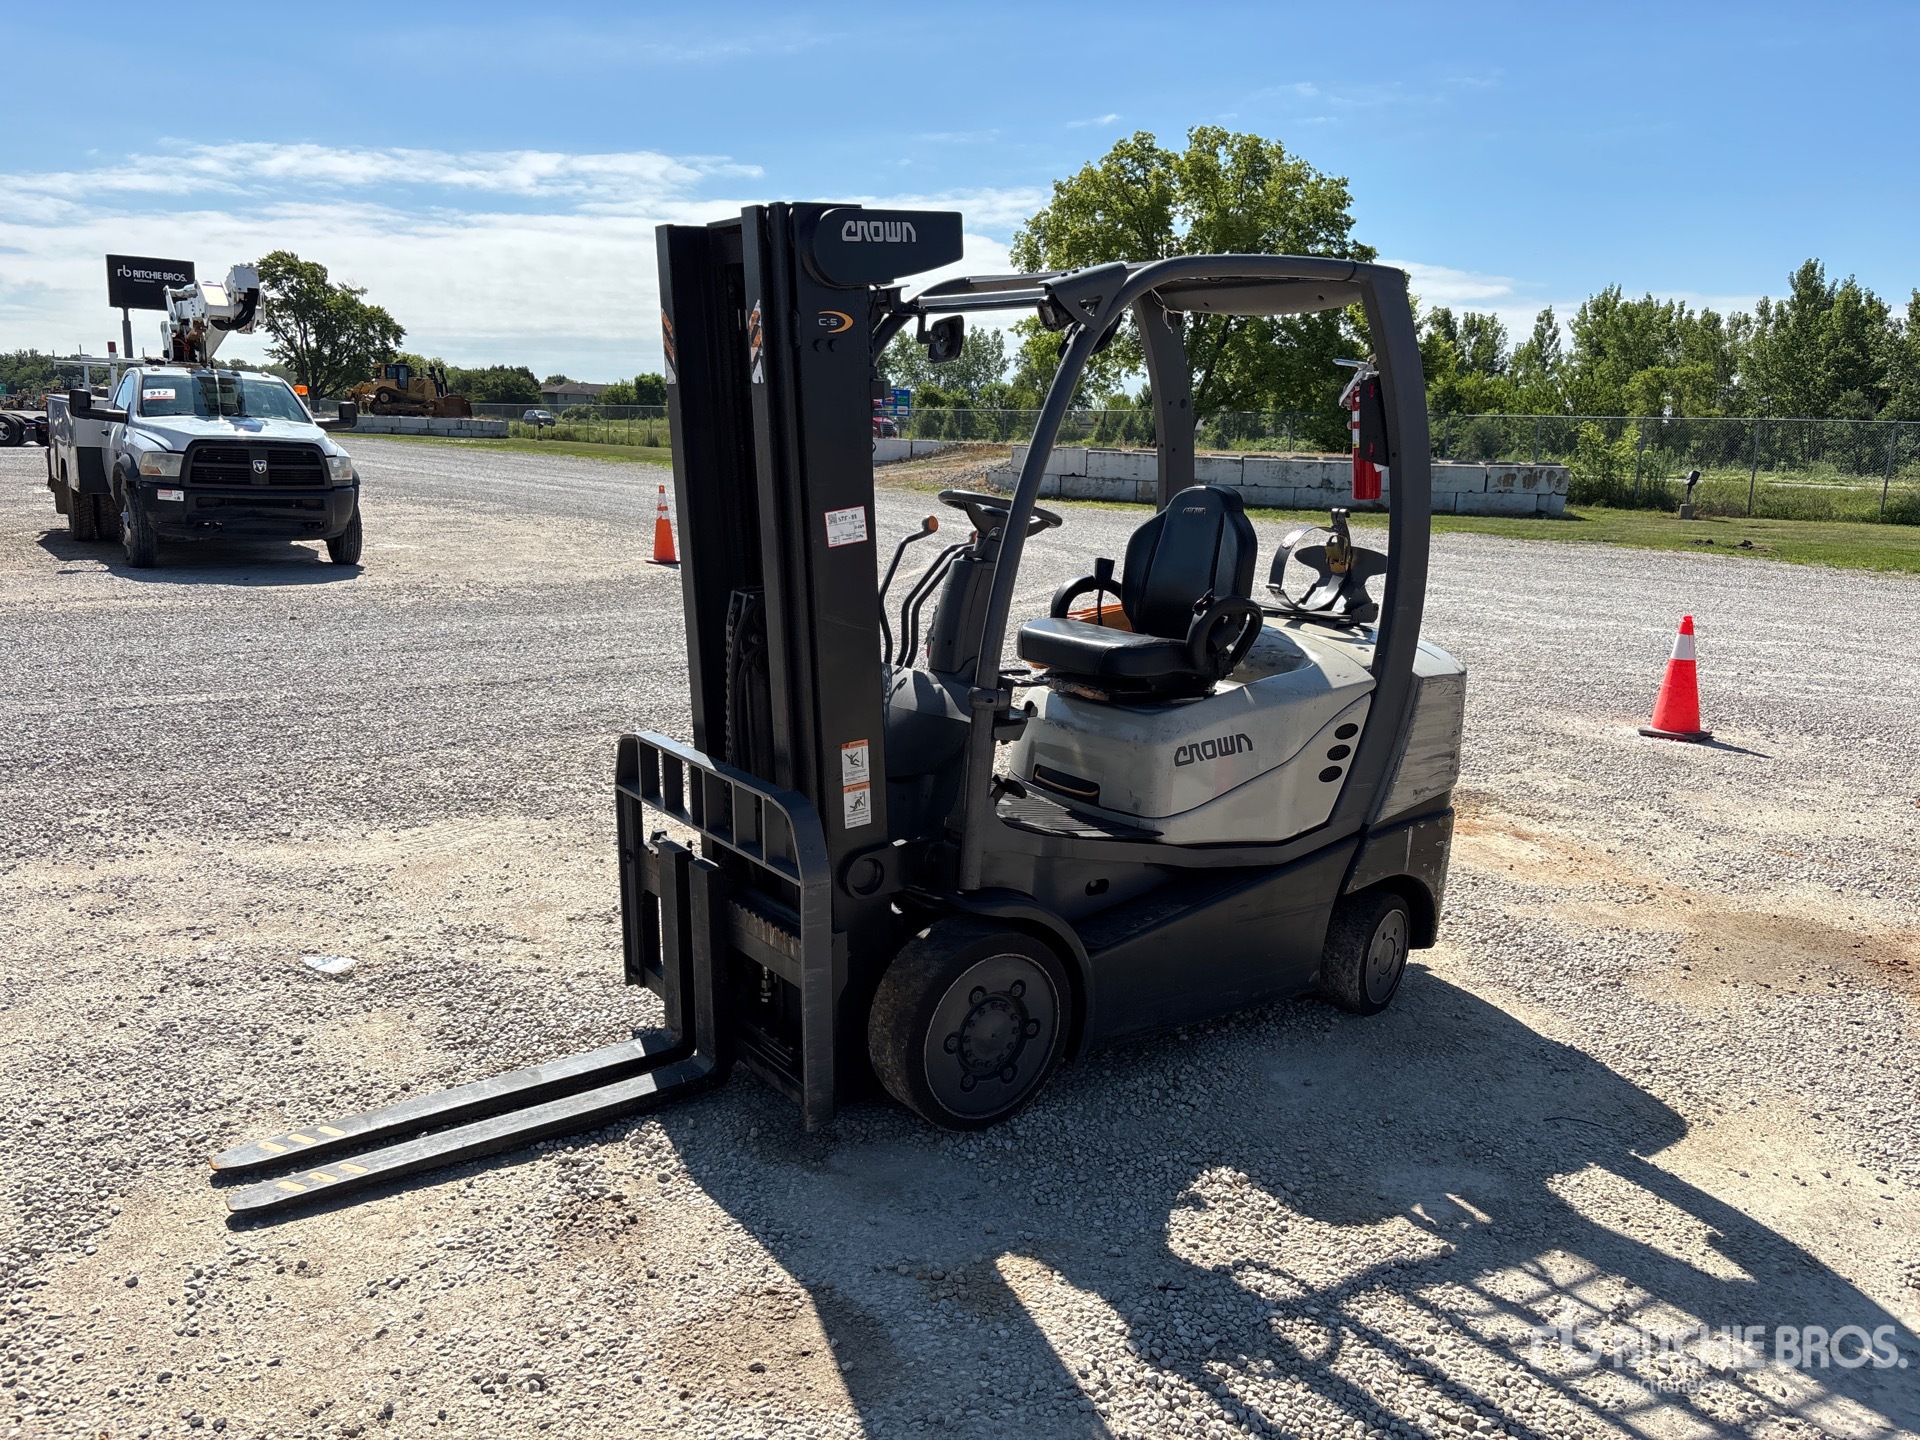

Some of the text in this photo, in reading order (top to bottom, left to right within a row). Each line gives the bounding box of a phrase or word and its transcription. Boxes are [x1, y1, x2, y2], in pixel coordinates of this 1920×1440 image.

[841, 220, 917, 243] CROWN
[132, 269, 162, 280] RITCHIE
[163, 271, 188, 282] BROS.
[1174, 733, 1254, 767] CROWN
